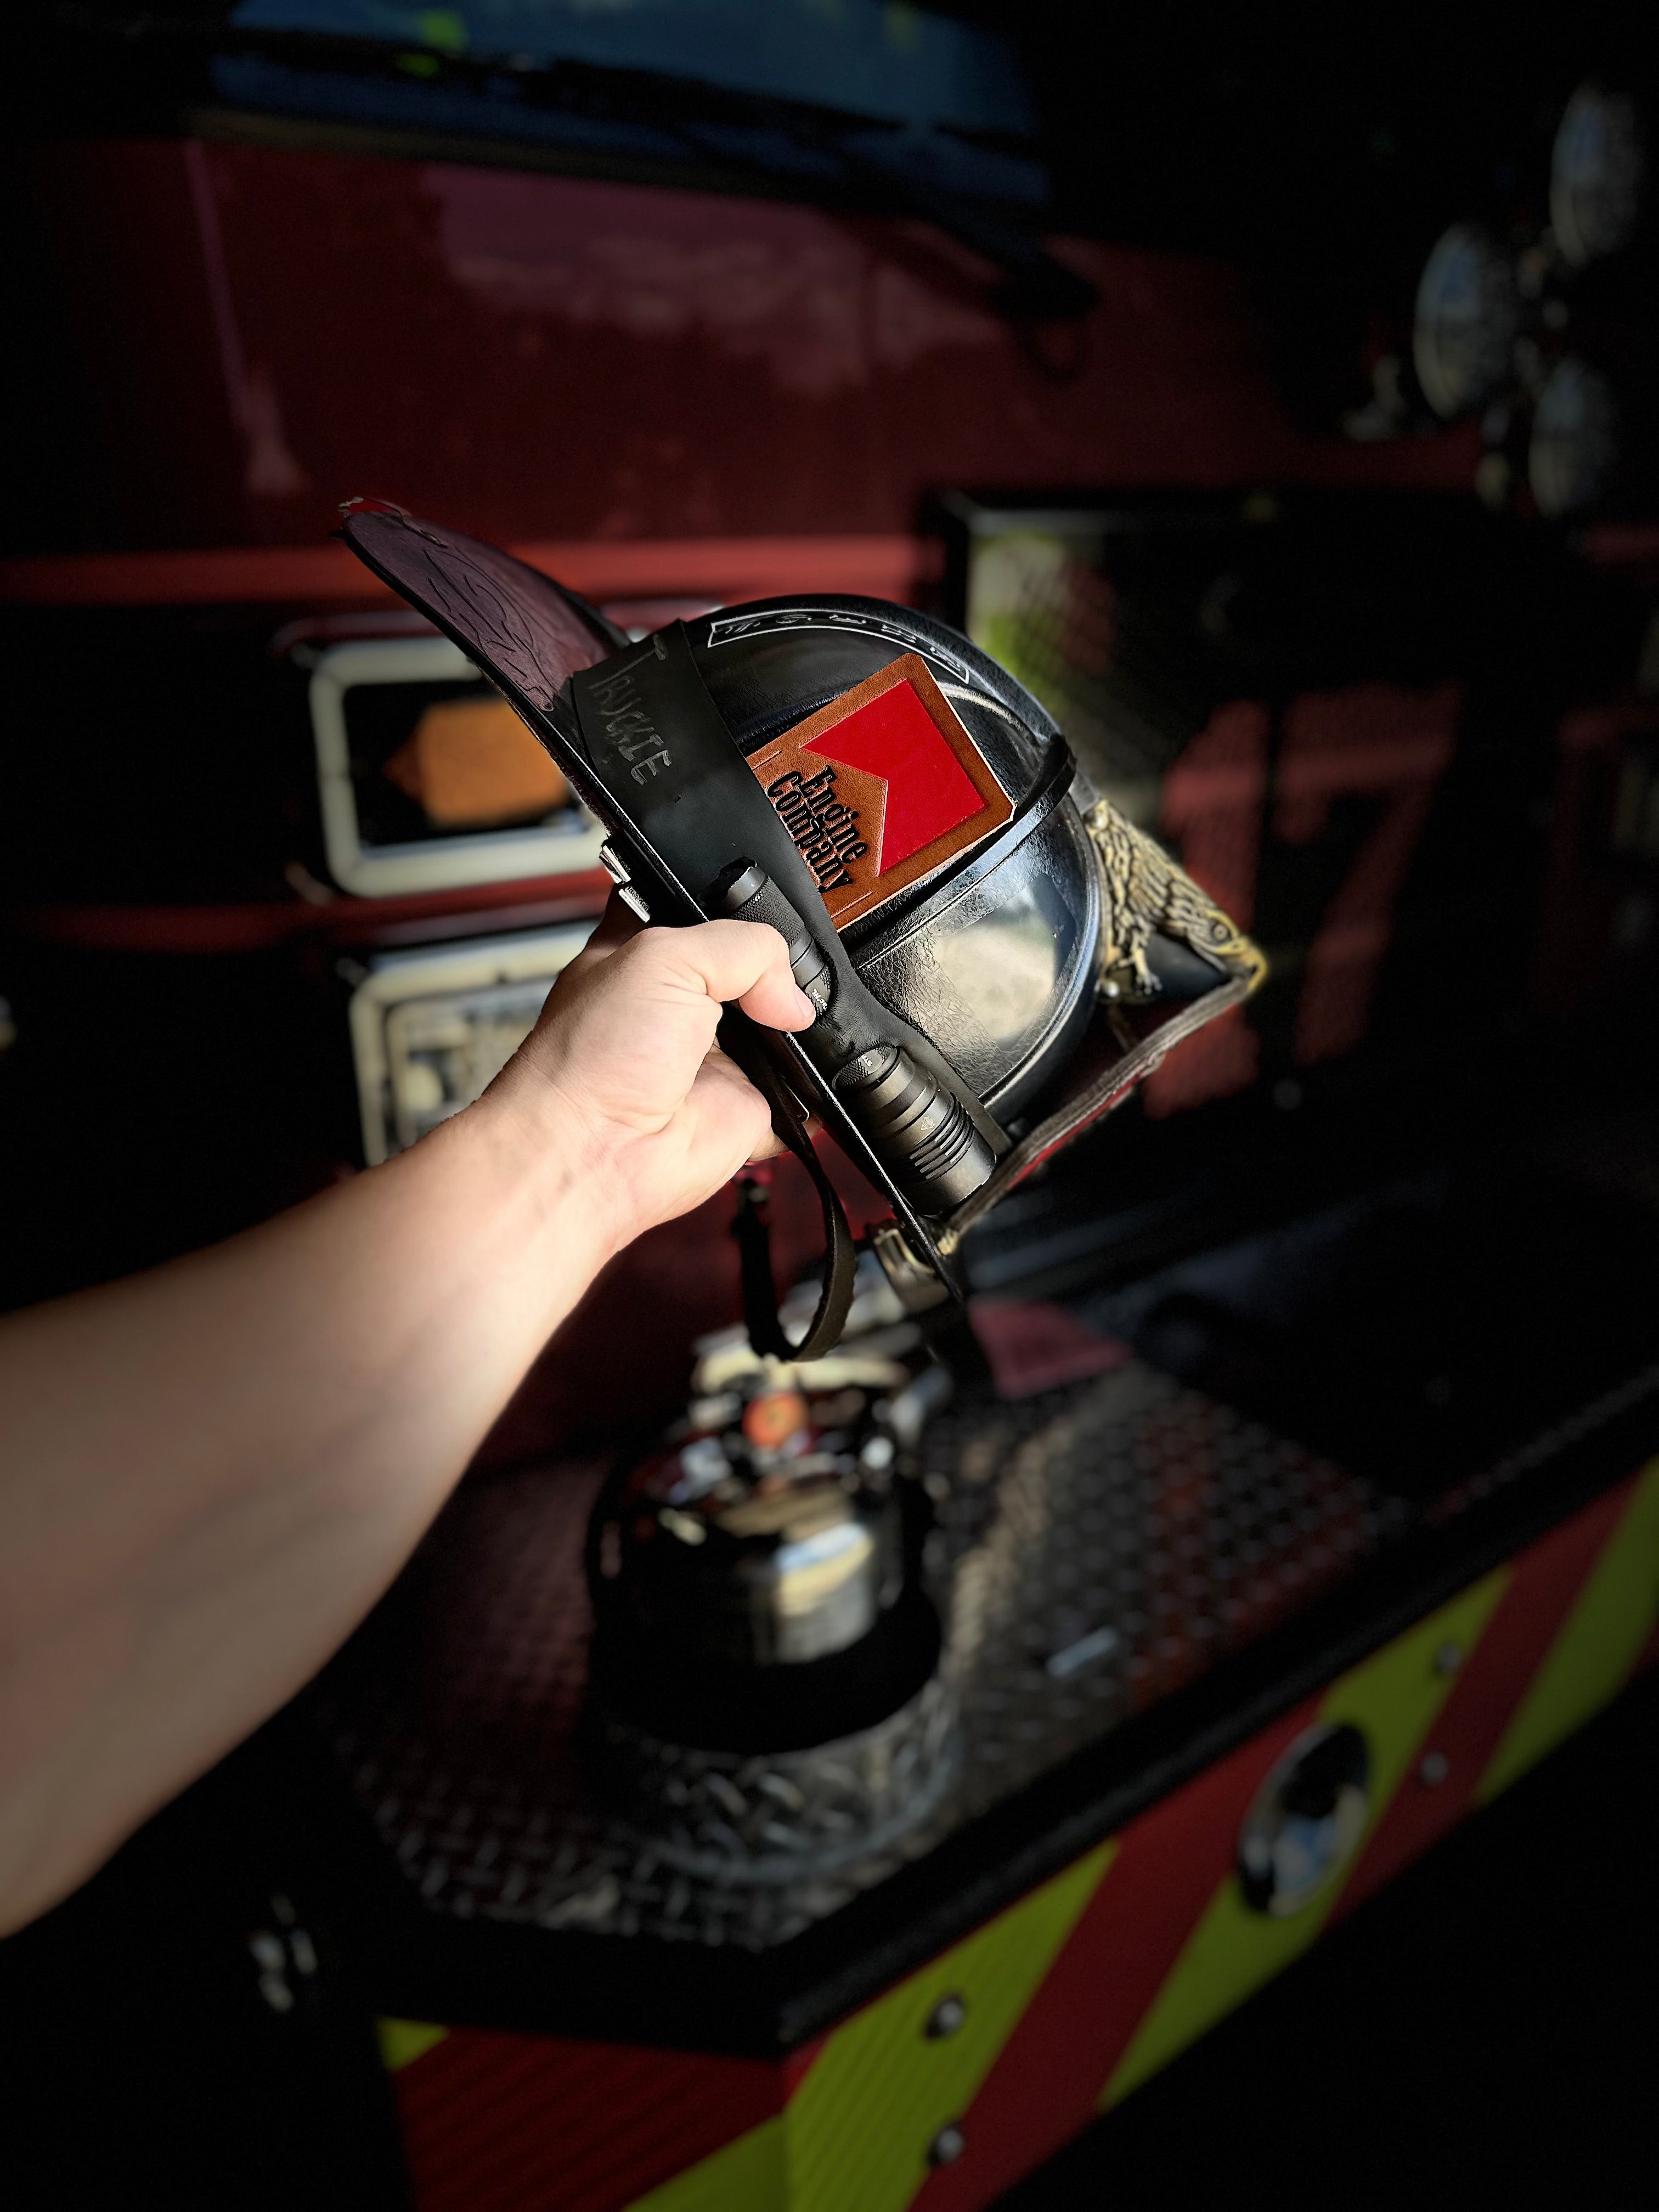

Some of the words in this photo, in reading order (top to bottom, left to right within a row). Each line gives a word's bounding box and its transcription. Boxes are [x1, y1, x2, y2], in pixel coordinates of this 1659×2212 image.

[587, 633, 673, 786] TRUCKIE
[767, 771, 854, 893] Company
[798, 764, 867, 864] Engine
[1140, 678, 1467, 1122] 17
